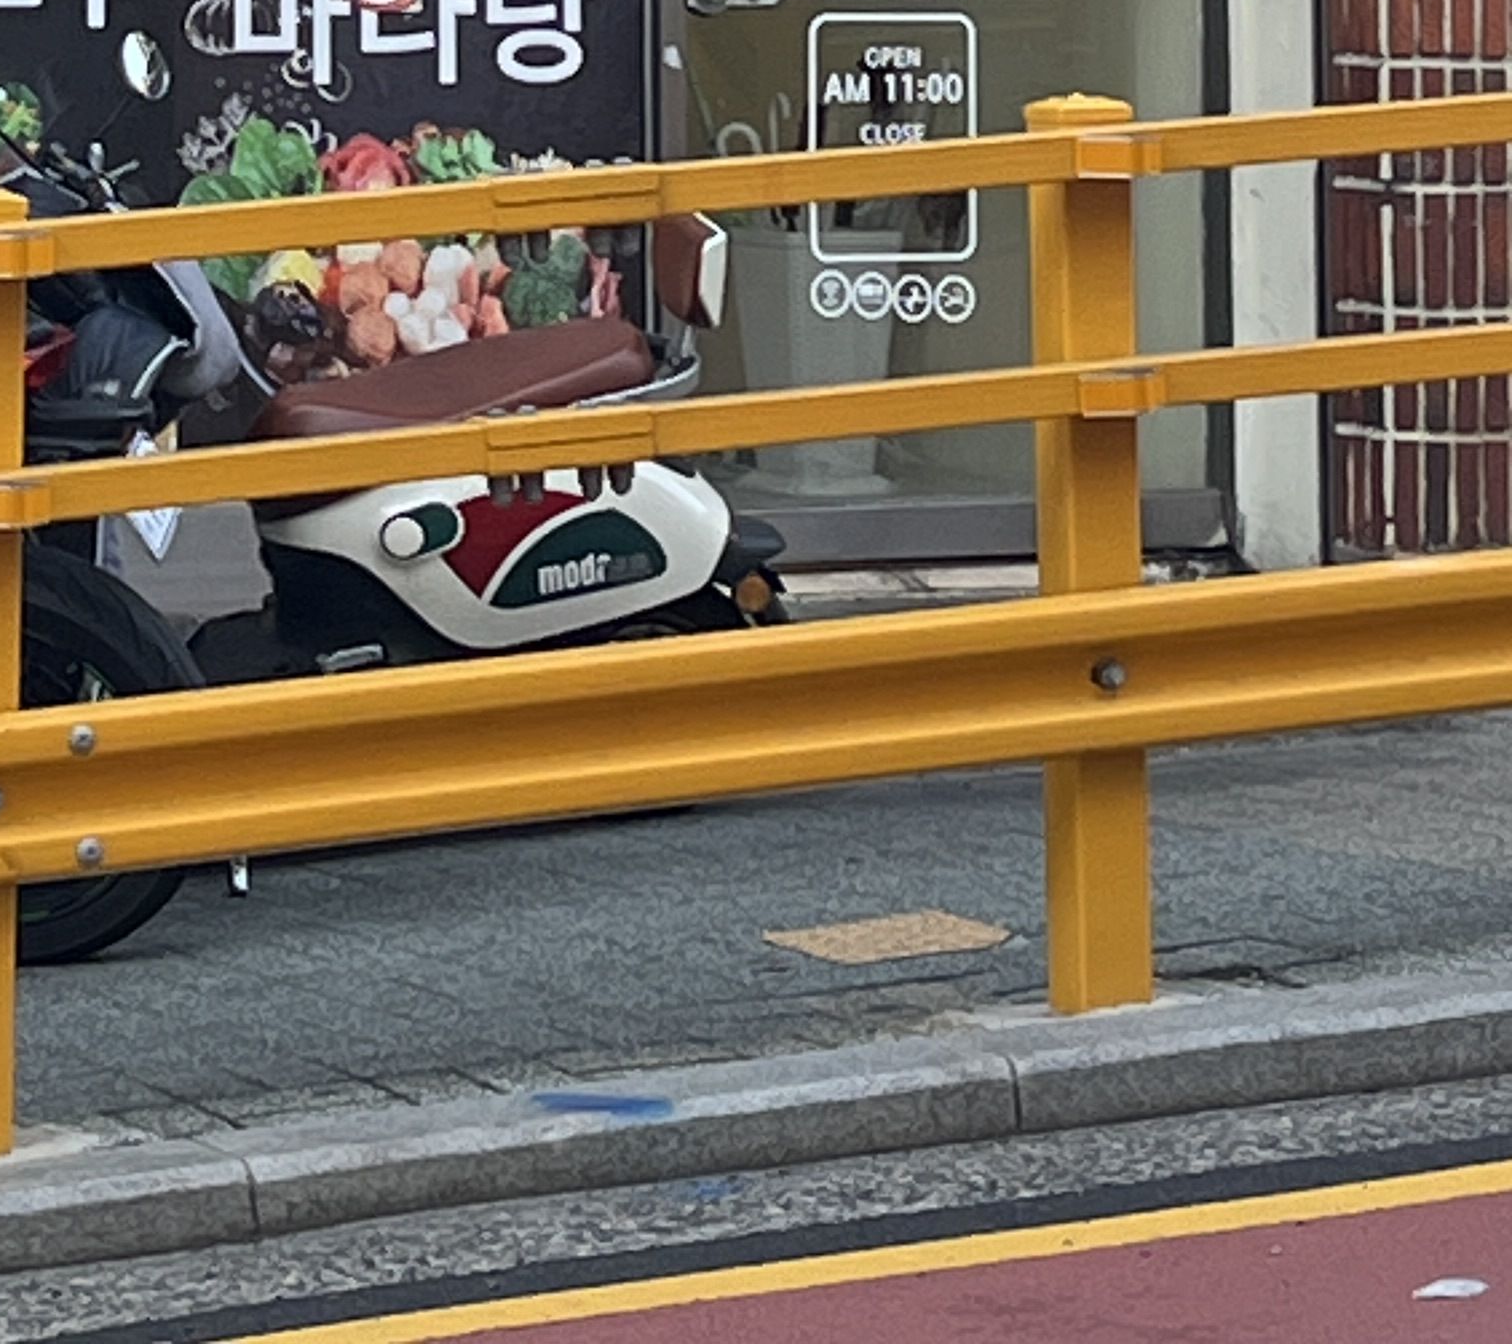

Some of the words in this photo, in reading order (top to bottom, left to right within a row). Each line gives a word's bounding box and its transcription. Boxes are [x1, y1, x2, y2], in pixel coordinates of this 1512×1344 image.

[863, 46, 922, 70] OPEN
[823, 73, 871, 105] AM
[884, 73, 964, 105] 11:00
[859, 122, 927, 147] CLOSE
